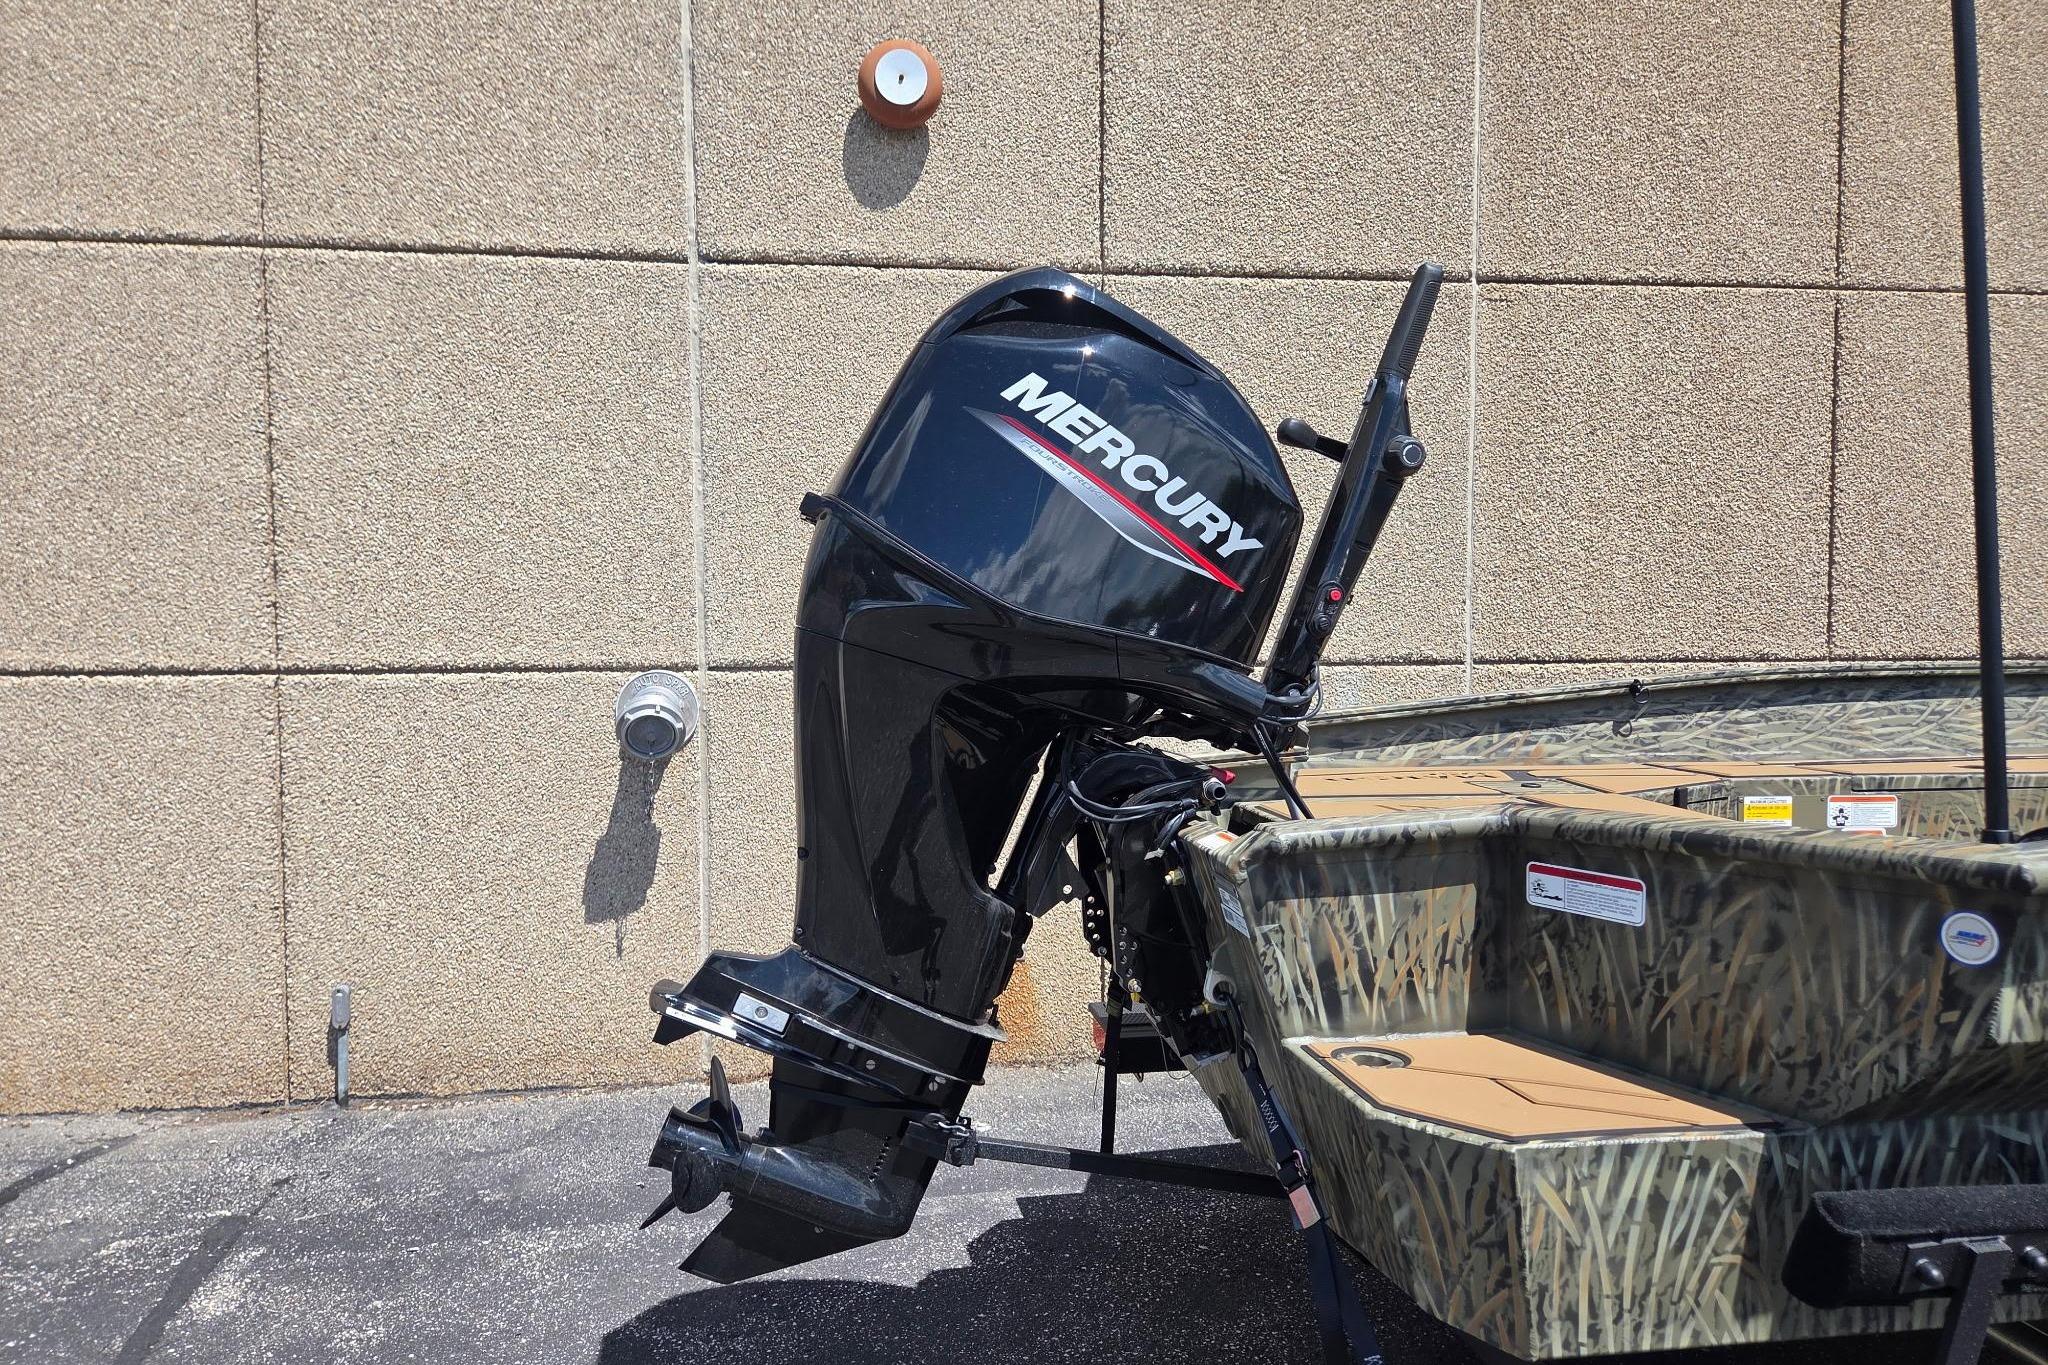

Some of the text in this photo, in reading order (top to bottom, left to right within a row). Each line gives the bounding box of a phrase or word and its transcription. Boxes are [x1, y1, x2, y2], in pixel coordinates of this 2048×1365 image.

[999, 372, 1264, 558] MERCURY
[1020, 438, 1109, 501] FOURSTROKE
[634, 673, 689, 697] AUTO SPKR
